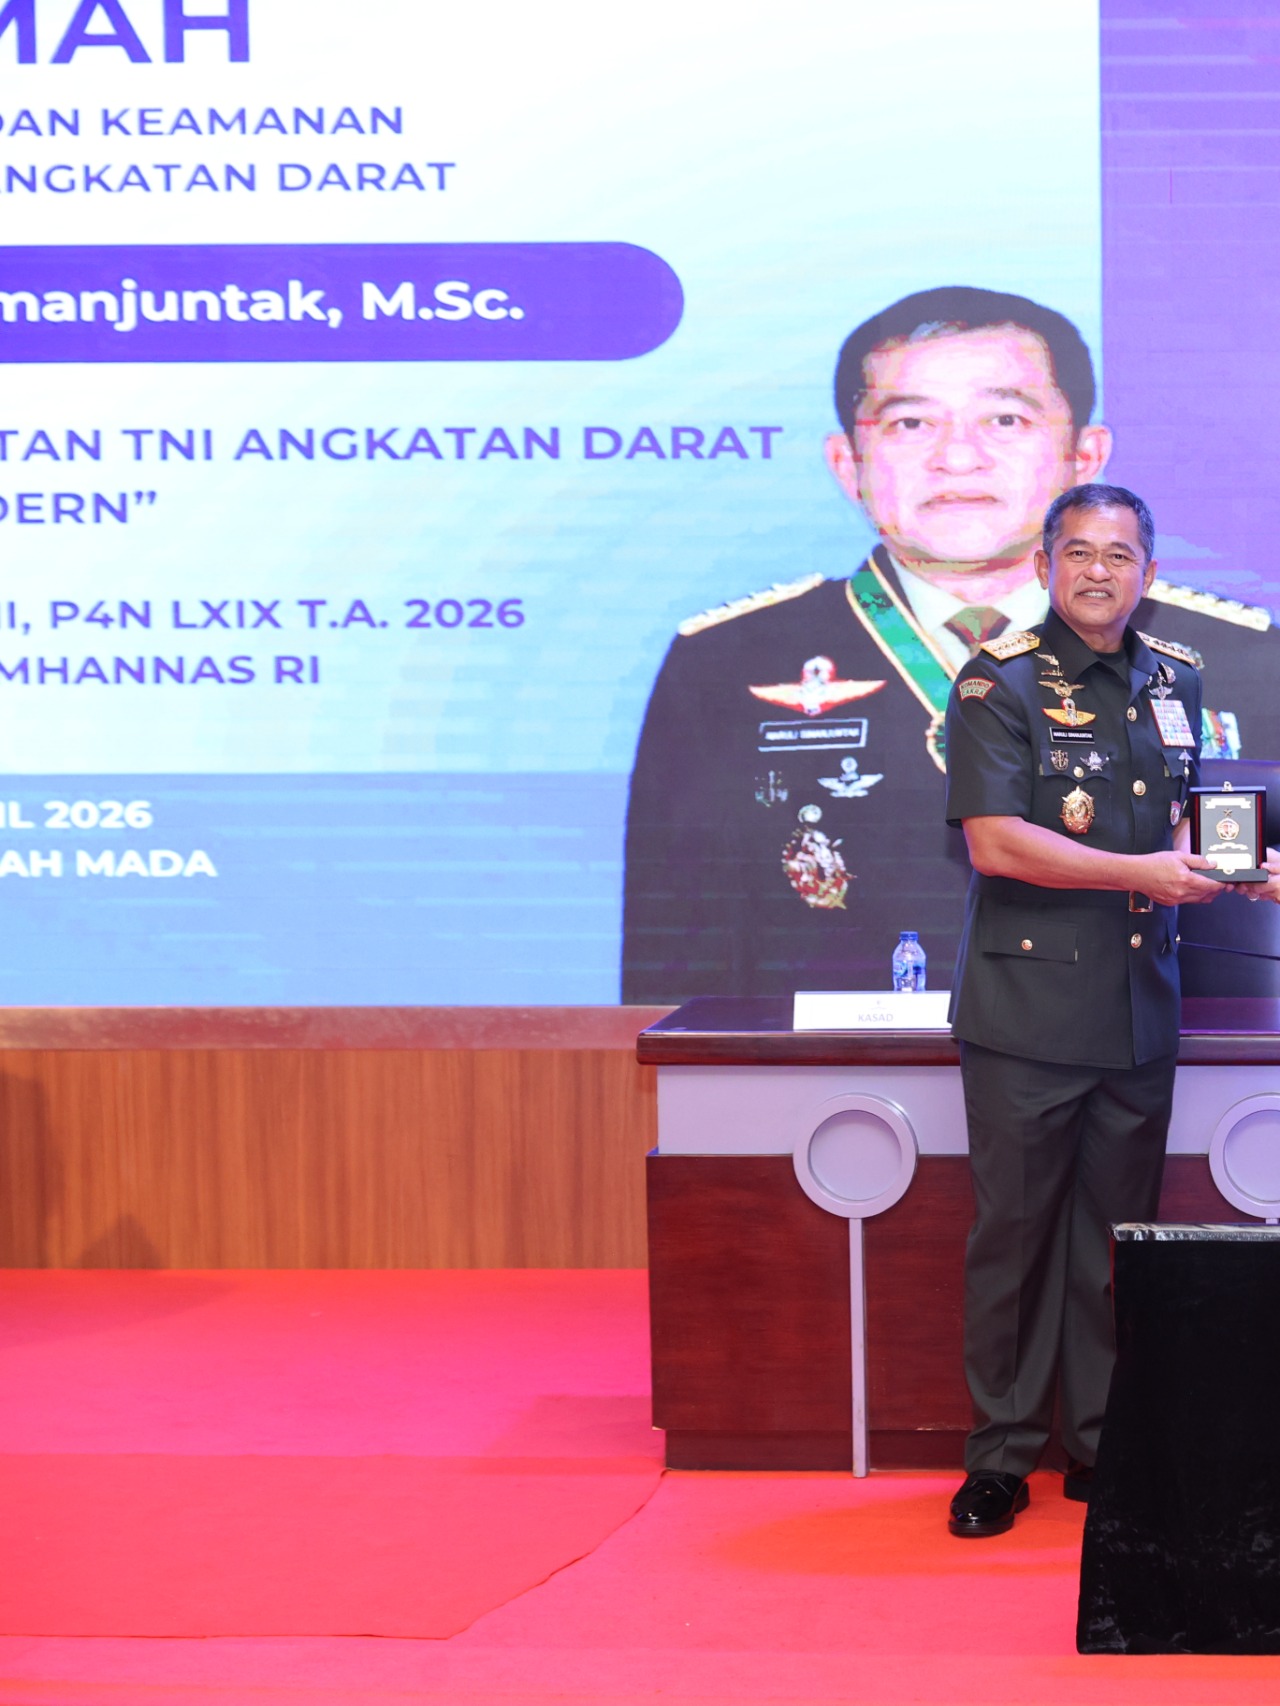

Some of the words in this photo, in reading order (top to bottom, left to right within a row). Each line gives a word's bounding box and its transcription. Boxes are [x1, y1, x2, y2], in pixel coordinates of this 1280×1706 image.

[0, 108, 80, 137] AN
[102, 107, 403, 136] KEAMANAN
[0, 163, 256, 194] NGKATAN
[278, 162, 456, 192] DARAT
[362, 281, 524, 321] M.Sc.
[121, 428, 213, 462] TNI
[233, 426, 562, 462] ANGKATAN
[581, 425, 784, 461] DARAT
[0, 490, 157, 525] ERN”
[49, 599, 152, 630] P4N
[171, 599, 283, 630] LXIX
[297, 598, 388, 630] T.A.
[404, 598, 525, 629] 2026
[273, 654, 321, 685] RI
[44, 800, 153, 829] 2026
[76, 849, 218, 878] MADA
[857, 1013, 894, 1023] KASAD
